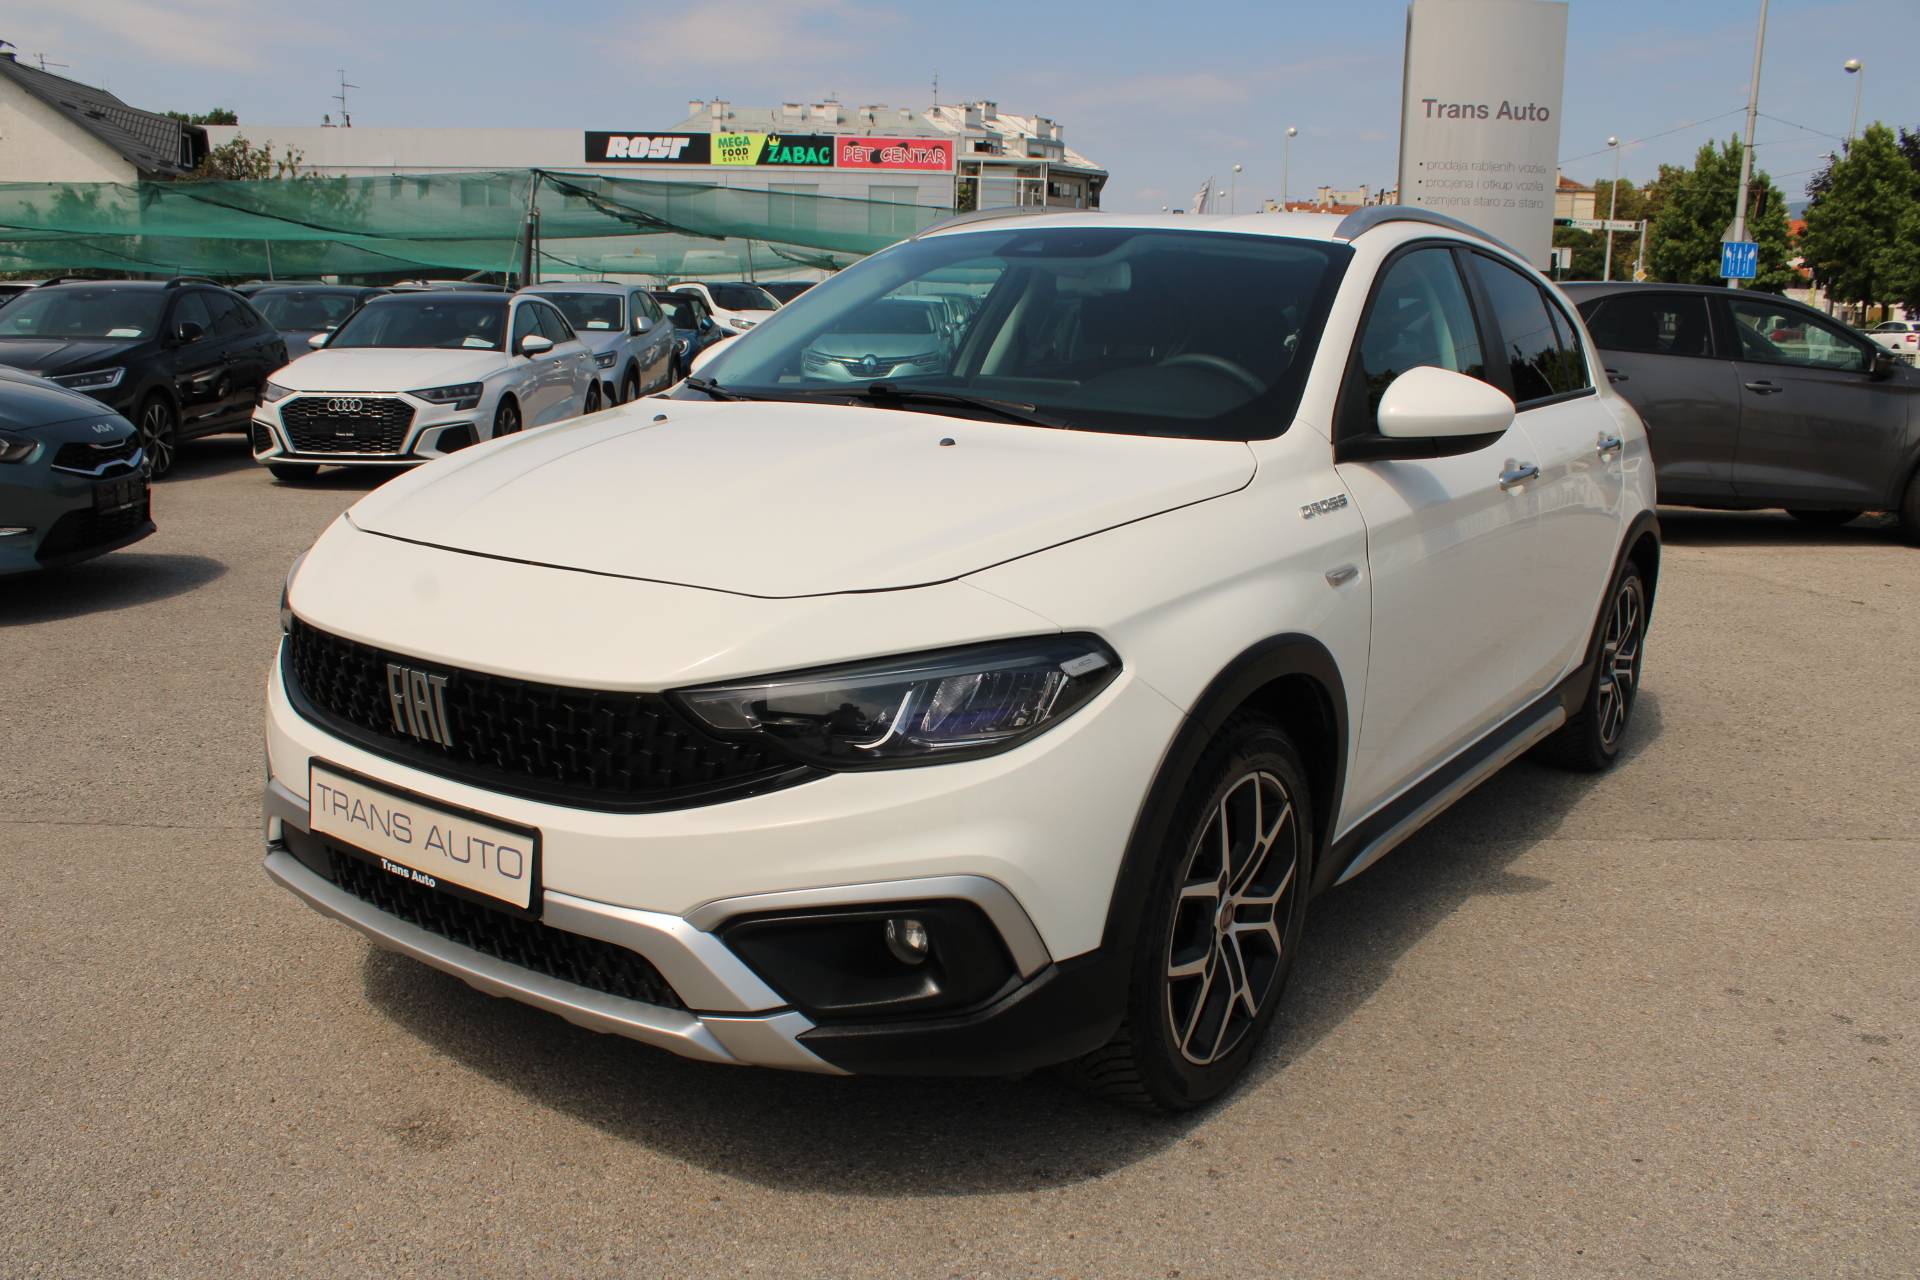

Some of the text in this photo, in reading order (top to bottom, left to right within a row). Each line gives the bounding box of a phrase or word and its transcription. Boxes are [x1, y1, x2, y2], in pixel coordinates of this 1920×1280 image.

[1422, 98, 1550, 122] Trans Auto
[605, 136, 690, 159] ROST
[718, 136, 750, 148] MEGA
[722, 147, 749, 157] FOOD
[843, 145, 946, 164] PET CENTAR
[1426, 160, 1468, 172] prodaja
[1482, 180, 1513, 191] otkup
[1516, 181, 1544, 192] vozila
[1473, 196, 1501, 207] staro
[1503, 199, 1516, 208] za
[1518, 198, 1544, 209] staro
[386, 662, 455, 748] FIAT
[316, 782, 524, 880] TRANS AUTO
[381, 858, 436, 888] Trans Auto
